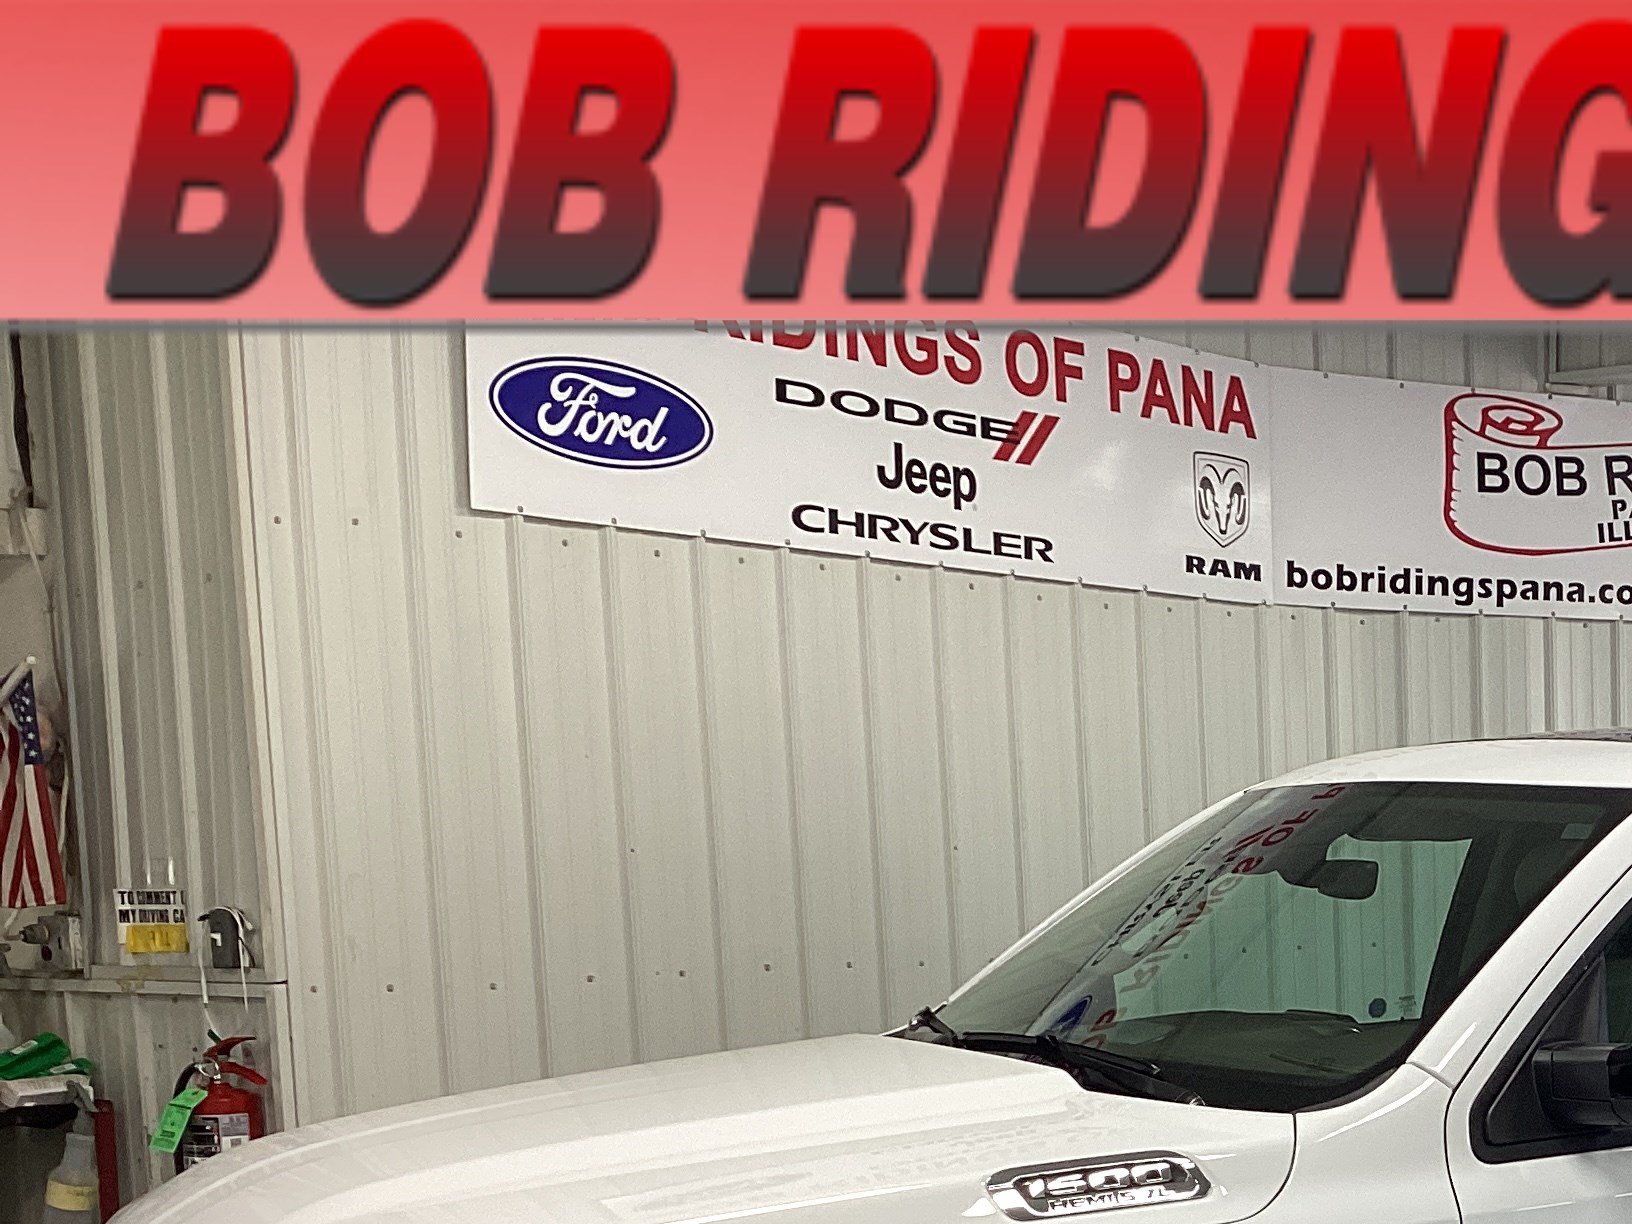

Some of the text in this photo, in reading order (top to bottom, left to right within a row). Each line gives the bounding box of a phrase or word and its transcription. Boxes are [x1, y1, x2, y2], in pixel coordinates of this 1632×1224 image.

[1004, 329, 1085, 403] OF
[1109, 348, 1257, 438] PANA
[537, 371, 669, 454] Ford
[775, 378, 1021, 443] DODGE
[877, 442, 977, 509] Jeep
[1477, 452, 1588, 497] BOB
[792, 504, 1054, 563] CHRYSLER
[1185, 555, 1262, 582] RAM
[118, 890, 135, 905] TO
[136, 890, 177, 905] COMMENT
[119, 908, 136, 923] MY
[1022, 1160, 1173, 1198] 1500
